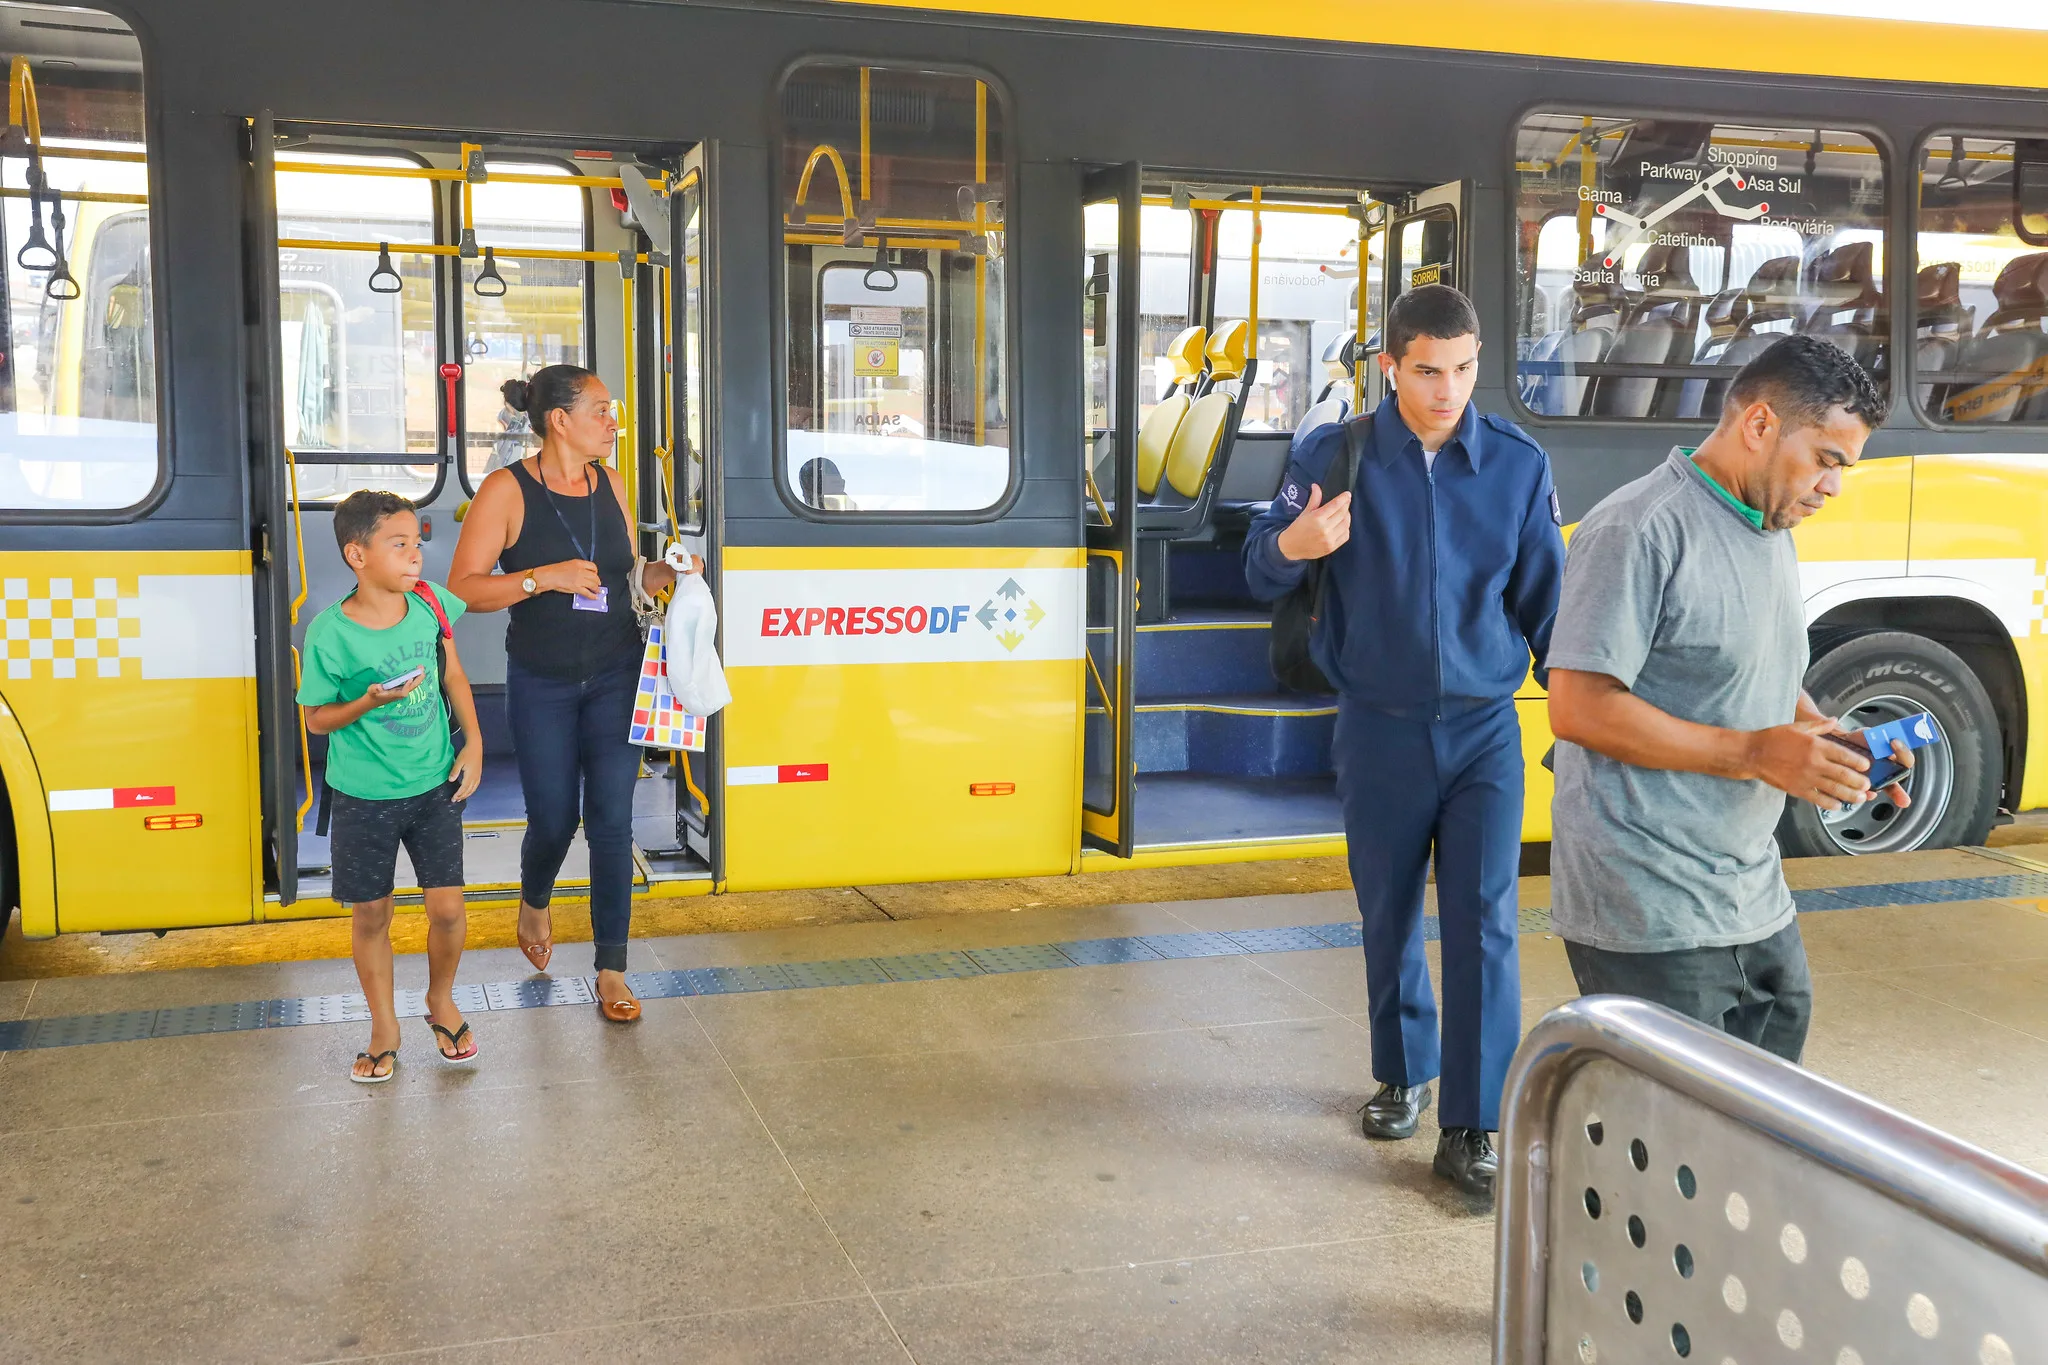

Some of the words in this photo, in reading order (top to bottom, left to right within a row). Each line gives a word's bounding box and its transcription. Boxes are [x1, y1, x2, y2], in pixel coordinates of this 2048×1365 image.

[1708, 147, 1777, 170] Shopping
[1640, 162, 1702, 185] Parkway
[1578, 186, 1623, 204] Gama
[1747, 176, 1774, 193] Asa
[1778, 178, 1801, 194] Sul
[1760, 216, 1835, 236] Rodoviária
[1647, 229, 1716, 248] Catetinho
[1412, 269, 1438, 286] SORRIA
[1573, 267, 1615, 284] Santa
[1620, 268, 1660, 287] Maria
[760, 605, 970, 637] EXPRESSODF
